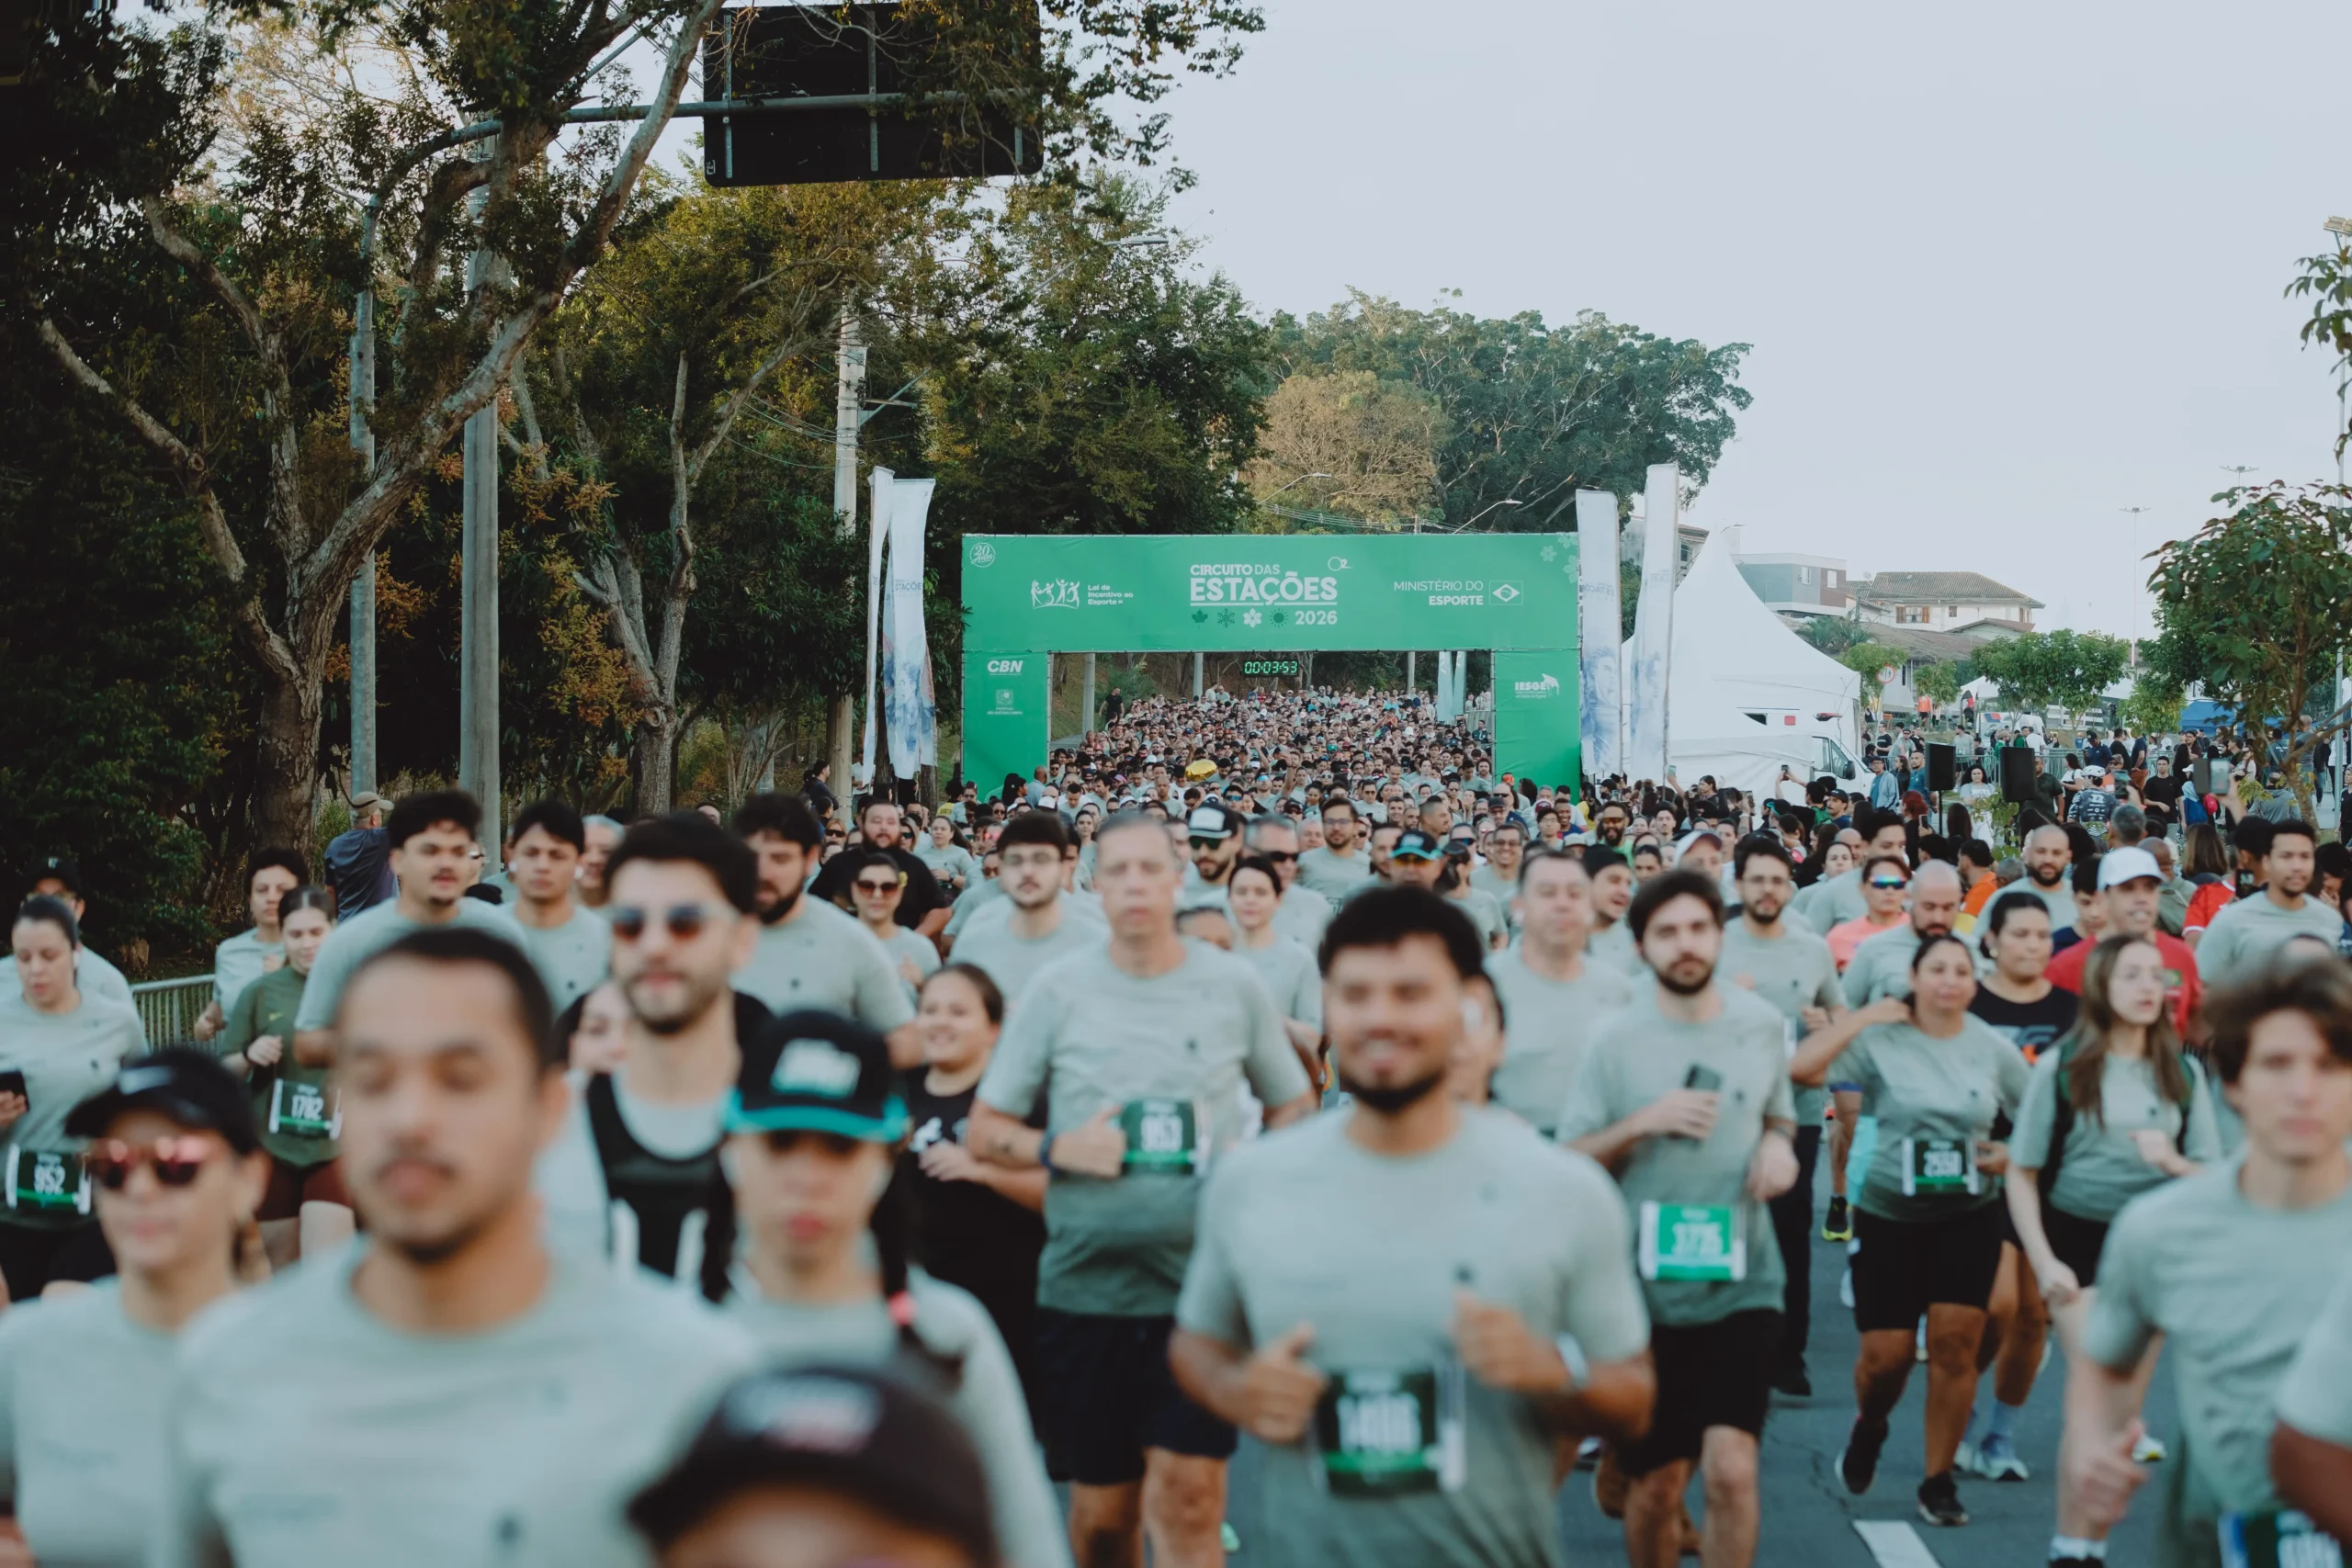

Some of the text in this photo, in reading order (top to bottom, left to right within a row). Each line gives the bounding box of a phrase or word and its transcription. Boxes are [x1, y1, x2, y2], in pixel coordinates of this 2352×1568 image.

[974, 545, 990, 556] 20
[1190, 563, 1281, 576] CIRCUITO DAS
[1190, 571, 1338, 605] ESTAÇÕES
[1394, 579, 1484, 592] MINISTÉRIO DO
[1429, 595, 1484, 606] ESPORTE
[1295, 610, 1338, 626] 2026
[987, 660, 1023, 673] CBN
[1244, 661, 1298, 674] 00:03:53
[1514, 682, 1547, 691] IESGE
[33, 1164, 66, 1195] 952
